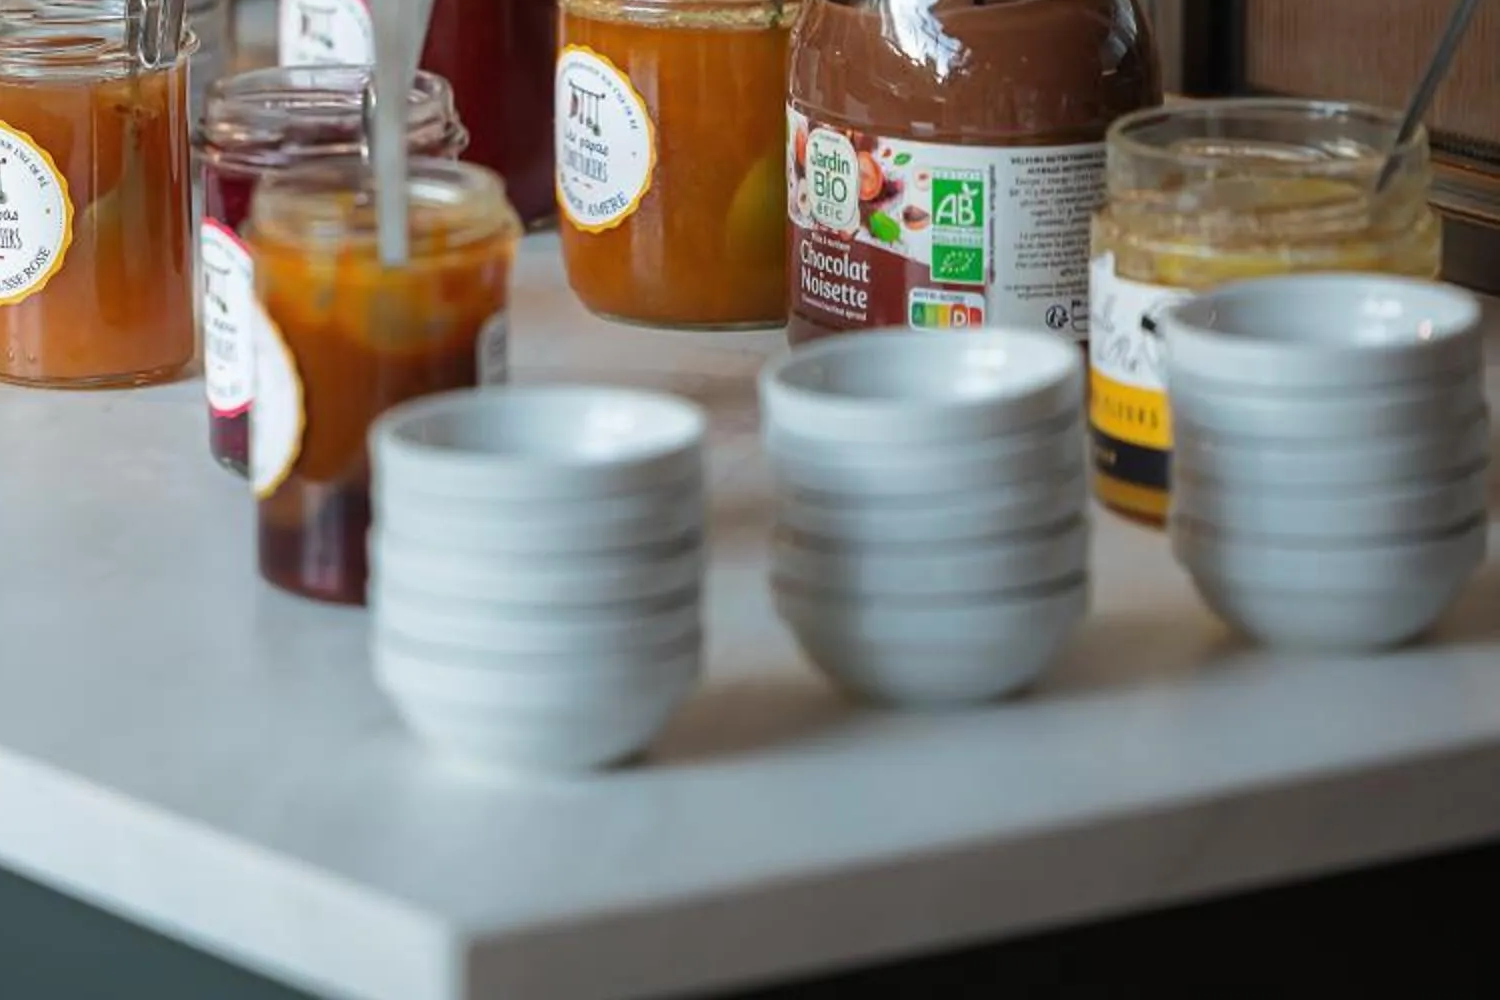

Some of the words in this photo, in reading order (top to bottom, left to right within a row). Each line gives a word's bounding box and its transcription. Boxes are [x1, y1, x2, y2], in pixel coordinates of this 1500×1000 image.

[810, 141, 850, 175] Jardin
[935, 191, 976, 226] AB
[23, 248, 51, 279] ROSE
[800, 240, 871, 284] Chocolat
[801, 266, 868, 309] Noisette
[953, 309, 967, 328] D
